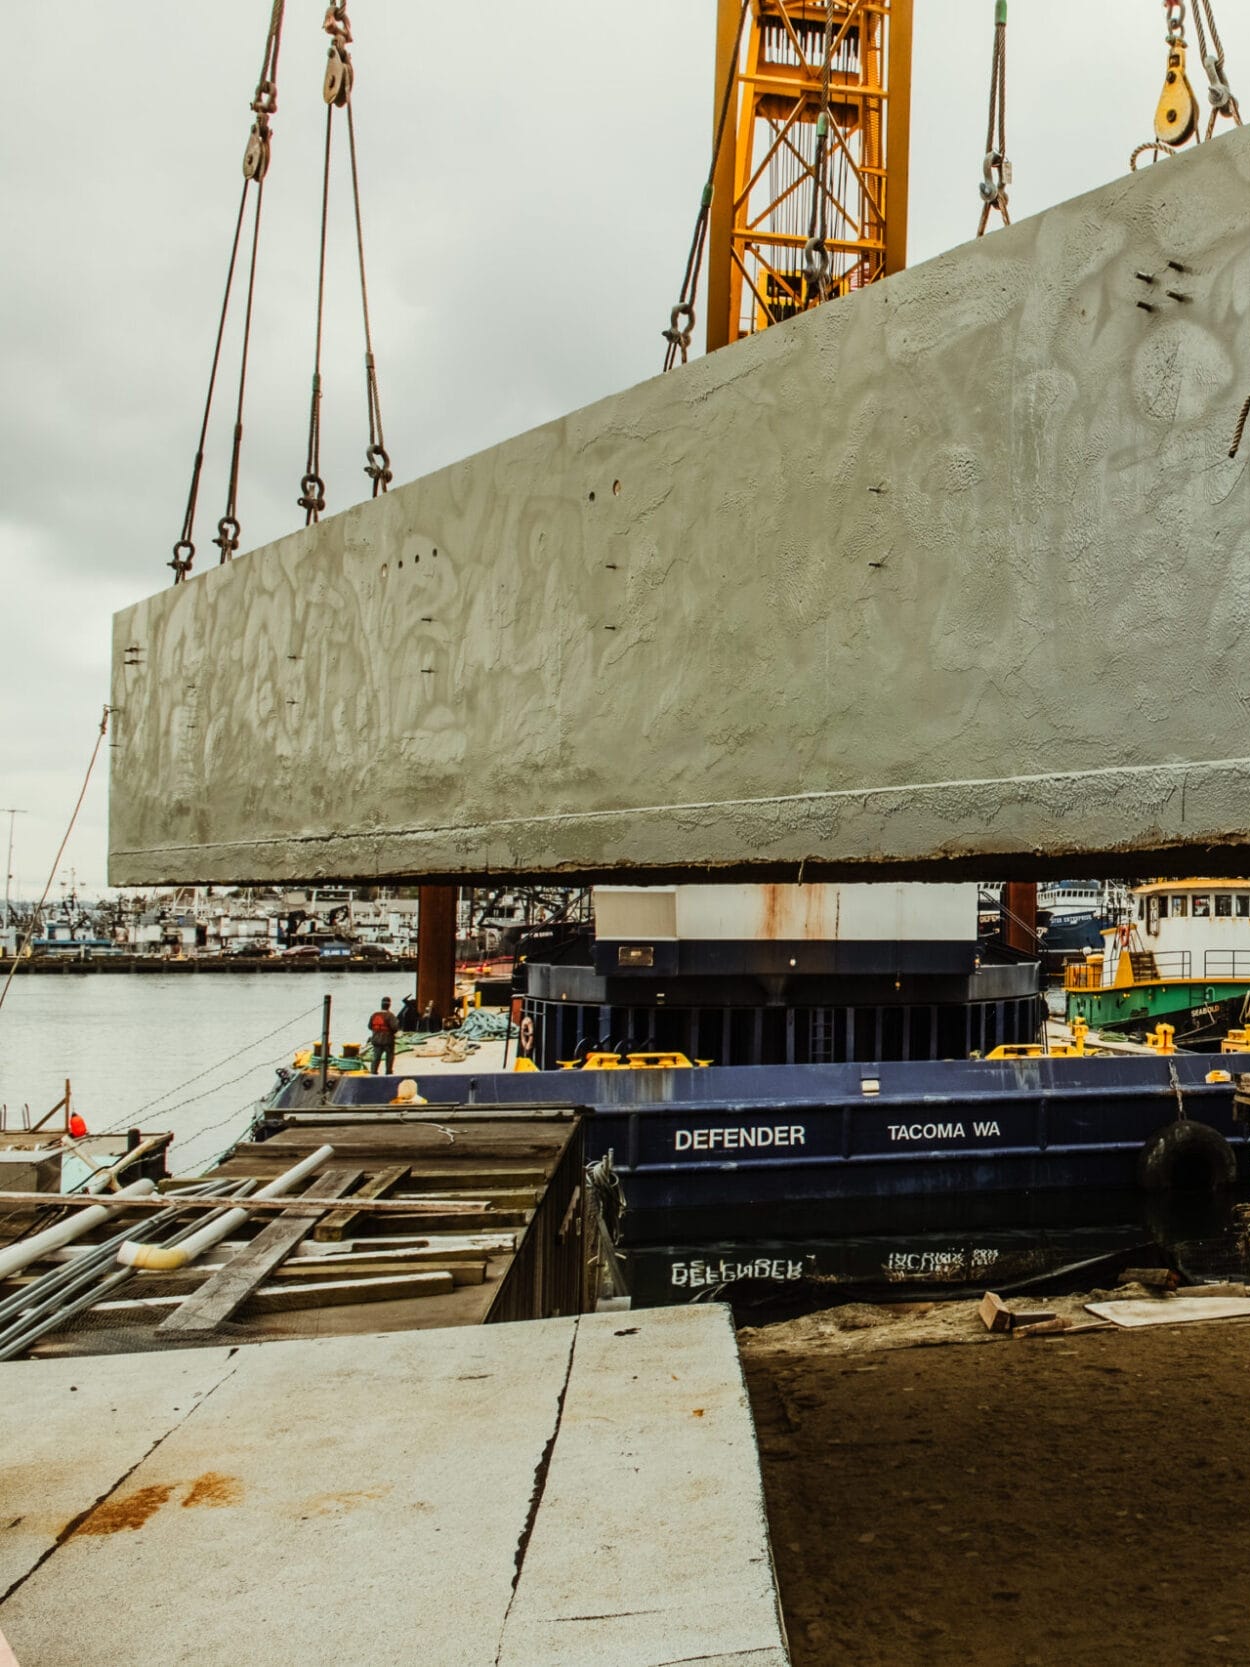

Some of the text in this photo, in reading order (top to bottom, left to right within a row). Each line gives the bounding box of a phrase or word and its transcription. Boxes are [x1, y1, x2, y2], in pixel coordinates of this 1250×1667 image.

[674, 1125, 806, 1151] DEFENDER
[887, 1121, 1001, 1141] TACOMA WA
